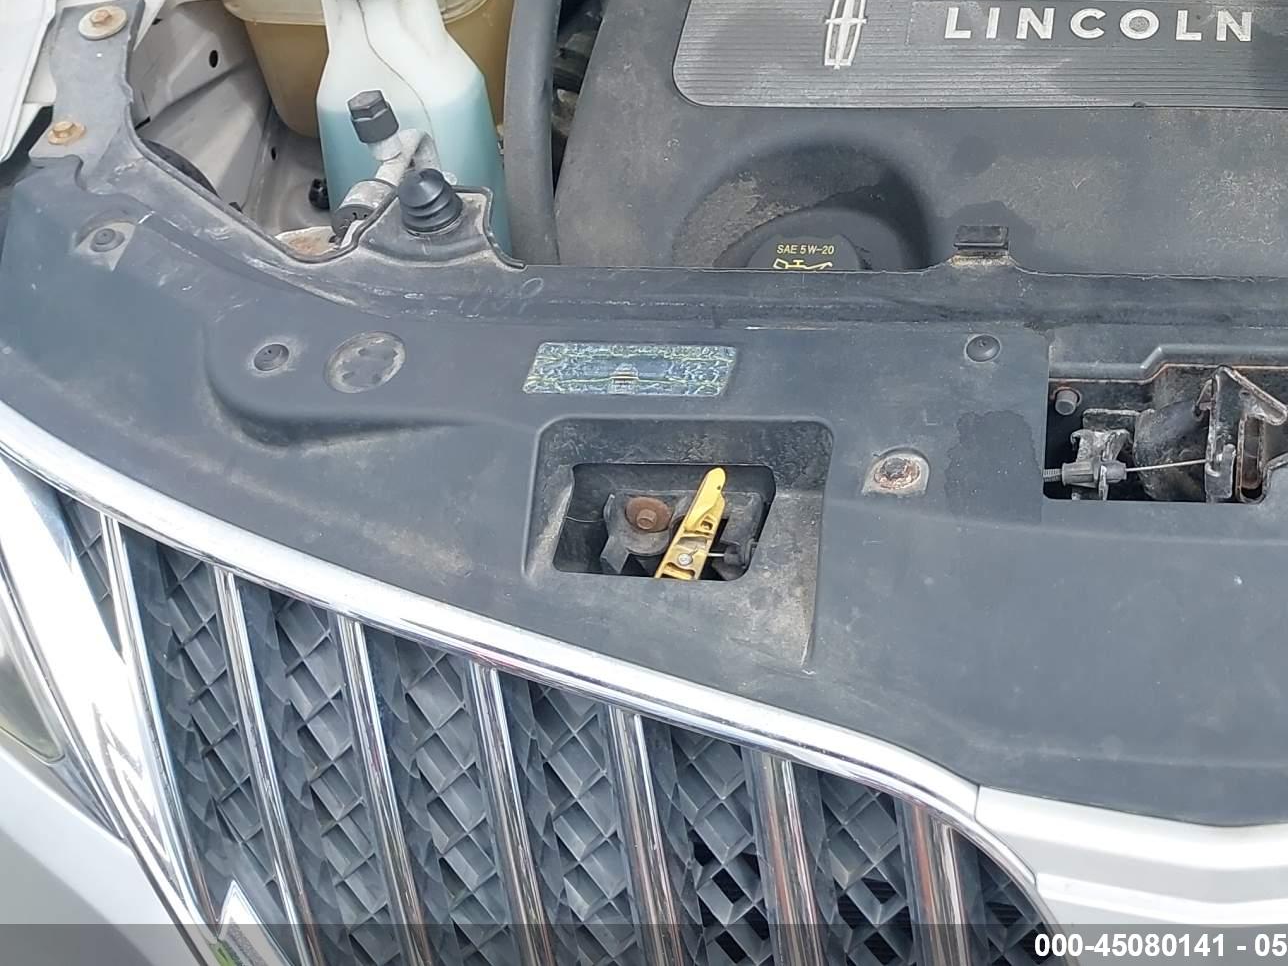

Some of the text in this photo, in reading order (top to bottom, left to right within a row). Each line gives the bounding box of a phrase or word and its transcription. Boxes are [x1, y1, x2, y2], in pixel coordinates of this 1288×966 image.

[944, 7, 1252, 42] LINCOLN
[777, 244, 835, 255] SAE 5W-20
